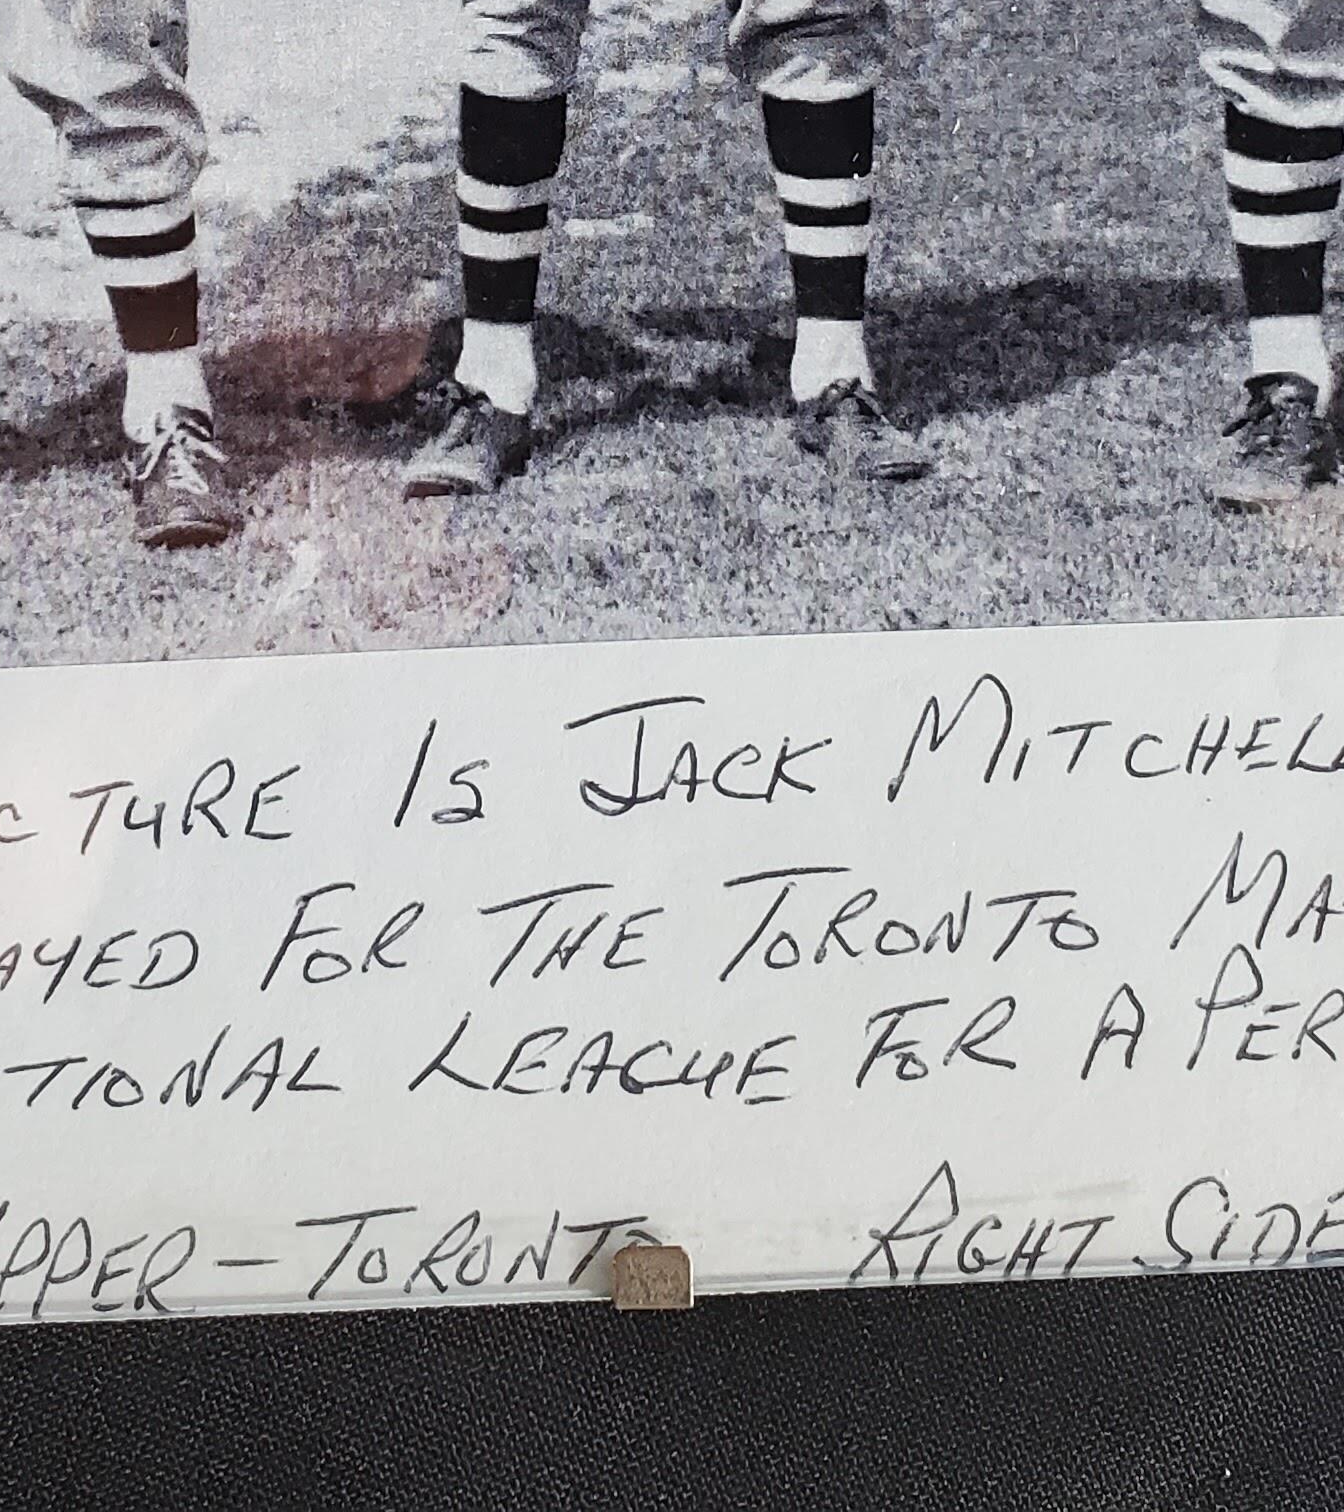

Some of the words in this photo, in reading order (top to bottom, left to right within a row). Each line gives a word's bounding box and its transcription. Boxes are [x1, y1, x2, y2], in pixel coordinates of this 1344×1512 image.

[394, 718, 490, 828] IS
[563, 696, 832, 816] JACK
[260, 882, 425, 991] FOR
[477, 883, 664, 988] THE
[718, 867, 1099, 982] TORONTO
[408, 1011, 797, 1105] LEAGUE
[856, 996, 1016, 1089] FOR
[1081, 983, 1145, 1080] A
[850, 1160, 1115, 1283] RIGHT
